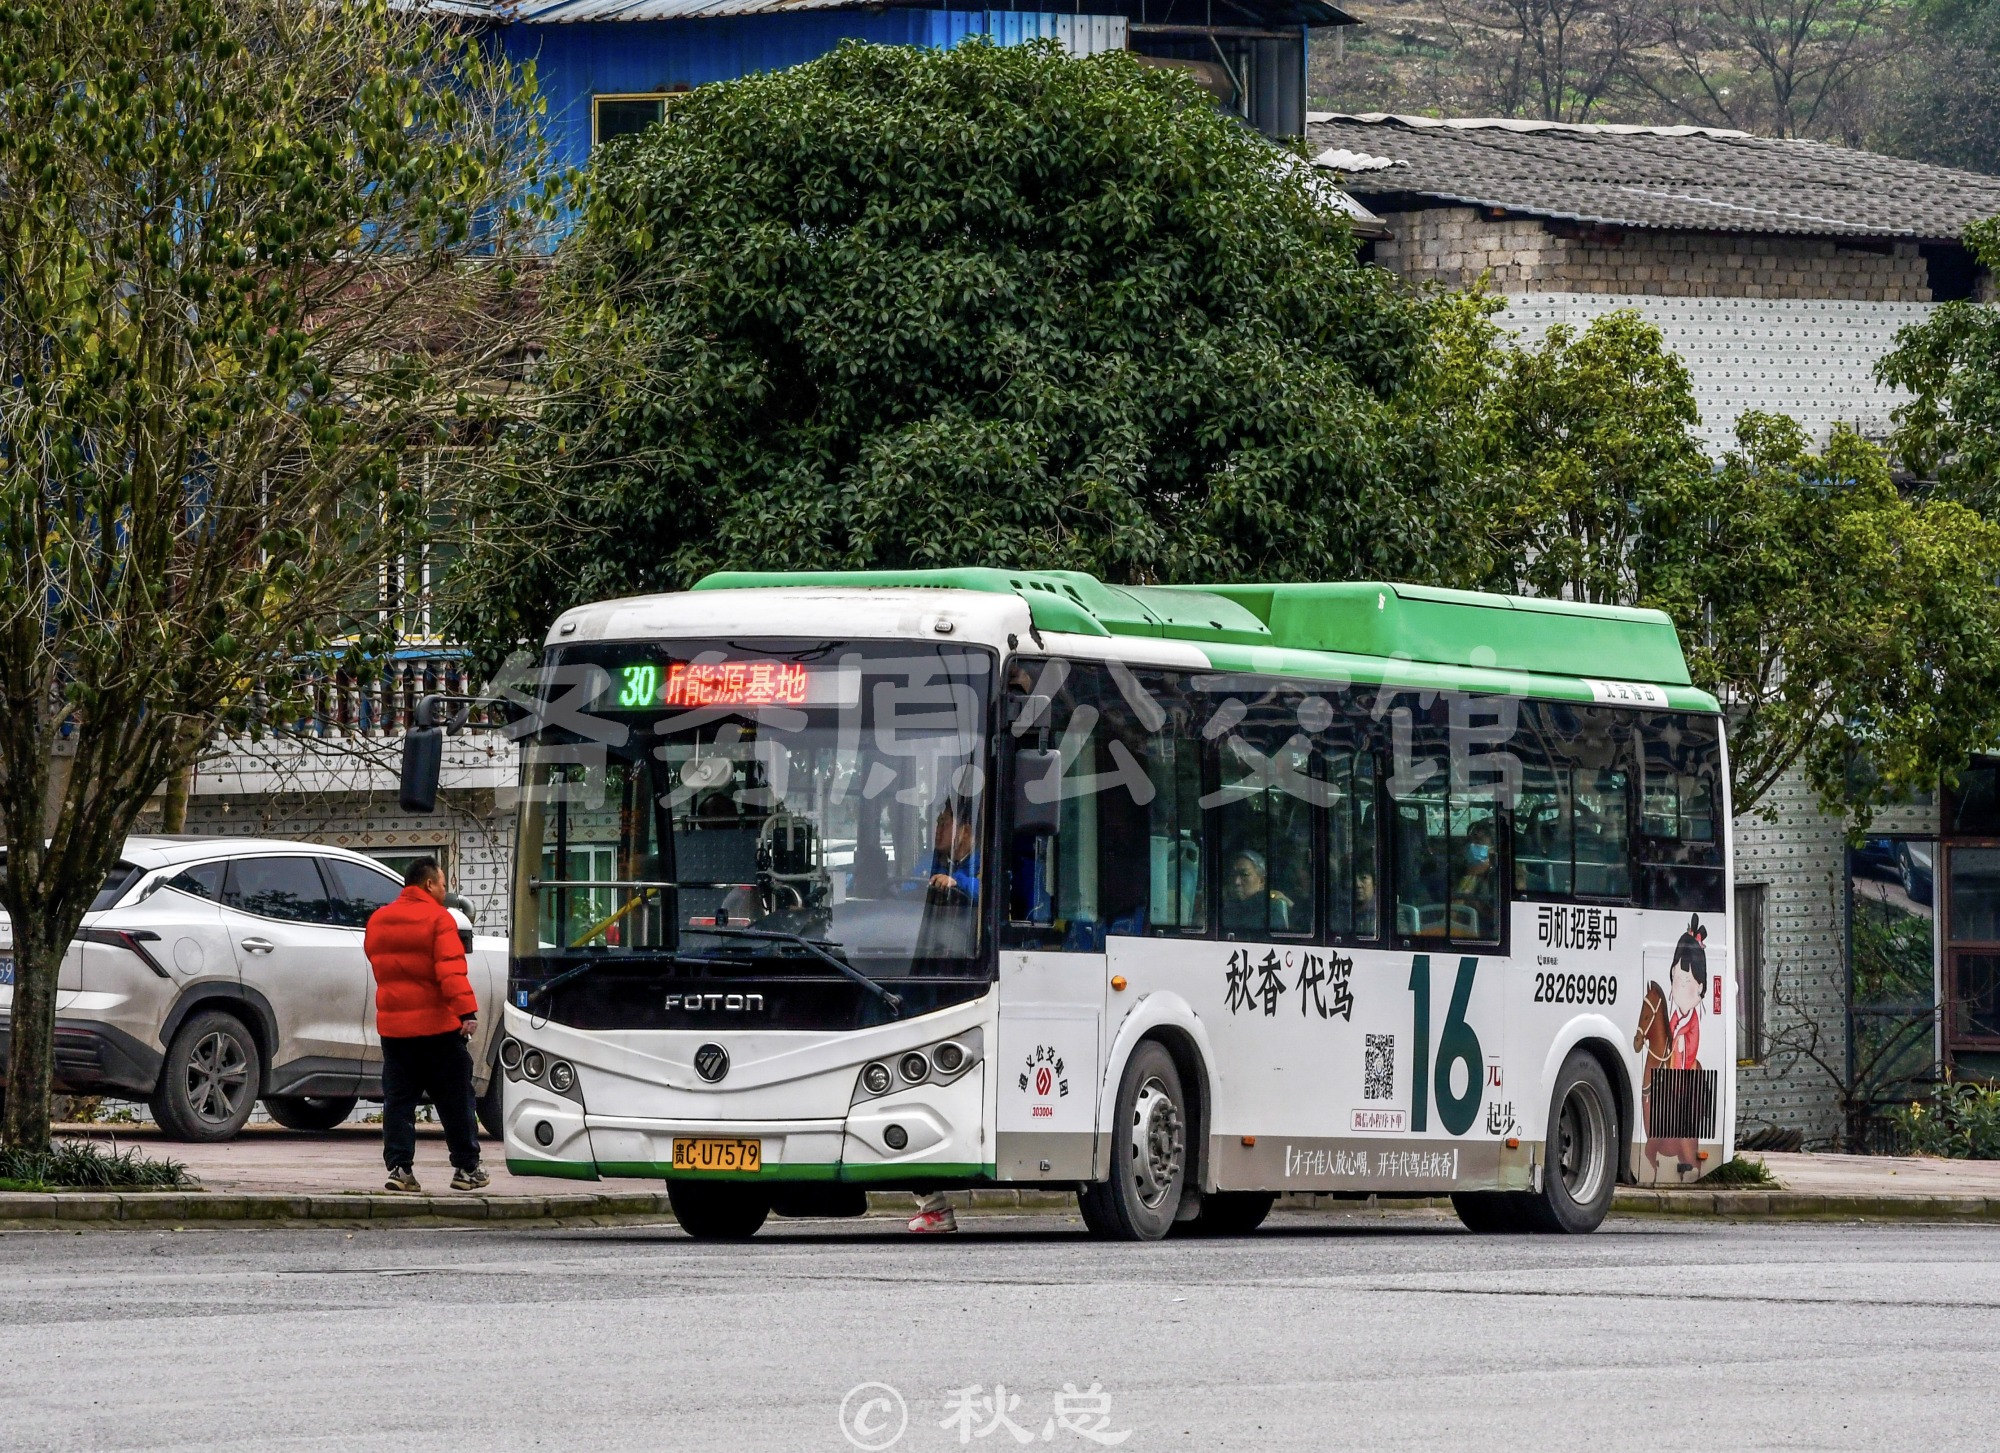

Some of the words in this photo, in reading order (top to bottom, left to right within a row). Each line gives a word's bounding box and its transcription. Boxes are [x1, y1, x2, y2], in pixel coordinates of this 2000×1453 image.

[621, 665, 655, 706] 30
[1537, 905, 1618, 951] 司机招募中
[665, 994, 763, 1011] FOTON
[1534, 972, 1618, 1006] 28269969
[1408, 955, 1484, 1136] 16
[1486, 1055, 1502, 1087] 元
